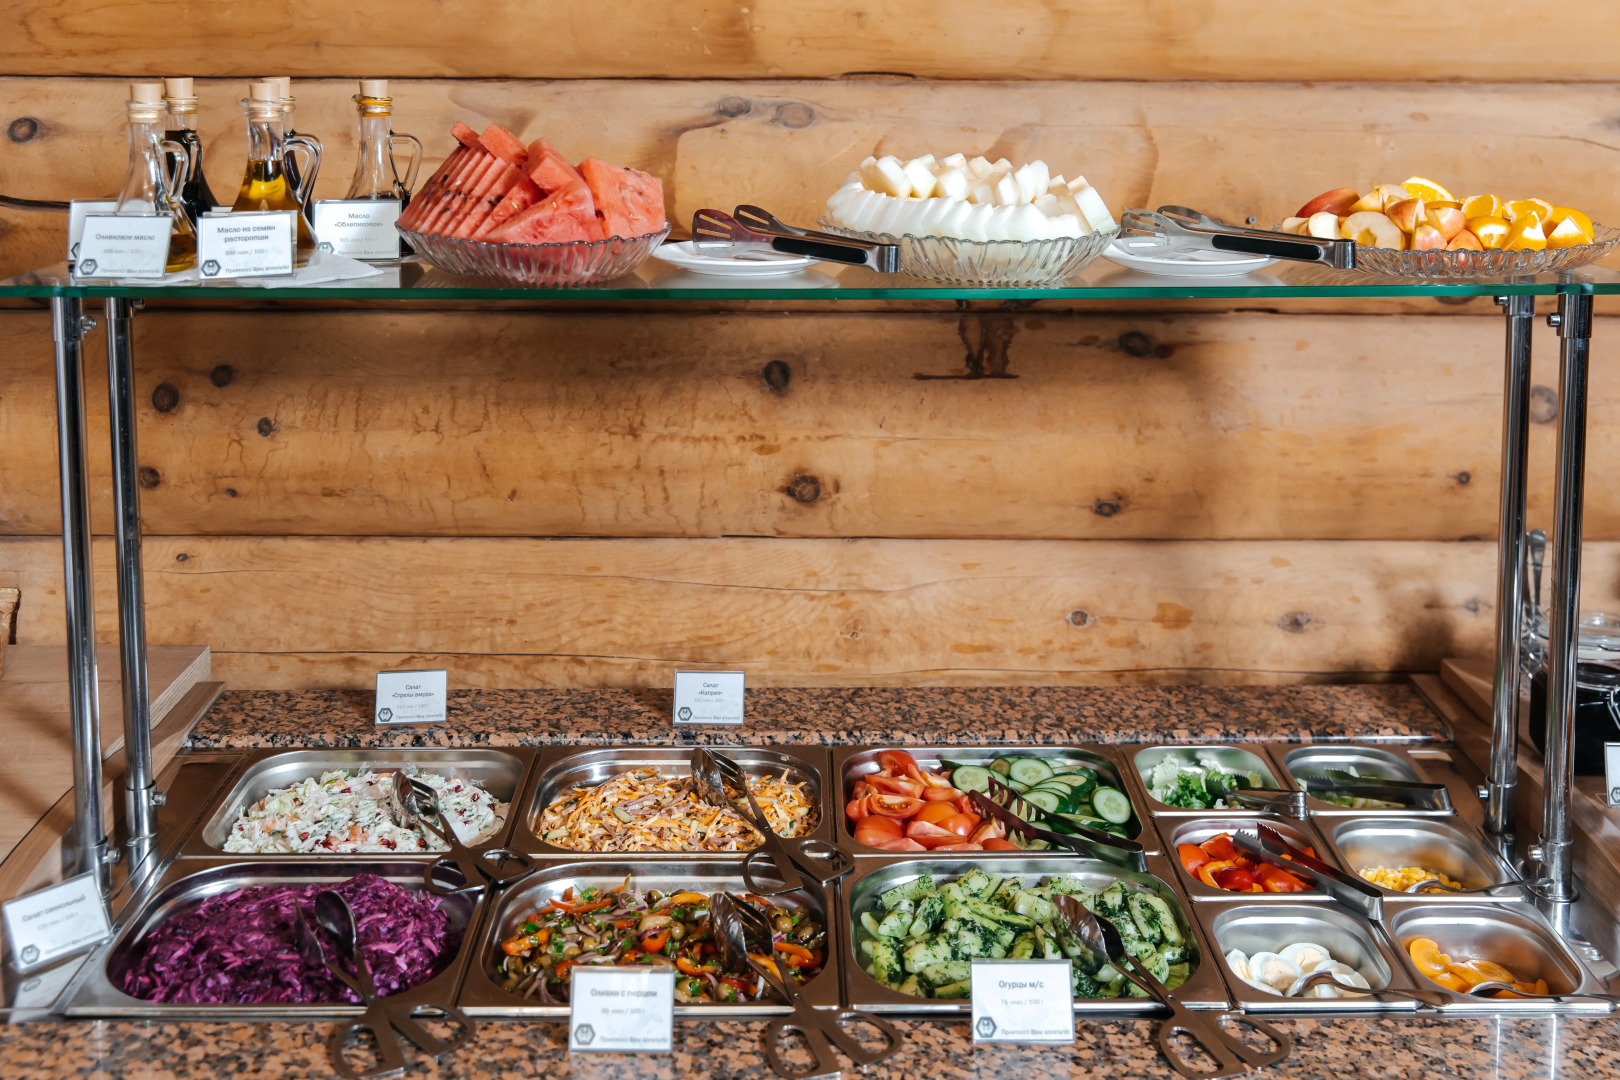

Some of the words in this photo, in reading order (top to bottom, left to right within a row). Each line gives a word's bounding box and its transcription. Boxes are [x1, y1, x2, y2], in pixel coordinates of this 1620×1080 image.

[224, 235, 269, 243] расторопши
[999, 980, 1027, 989] Огурцы
[1029, 981, 1043, 989] м/с
[591, 988, 619, 997] Оливки
[627, 990, 657, 998] перцем
